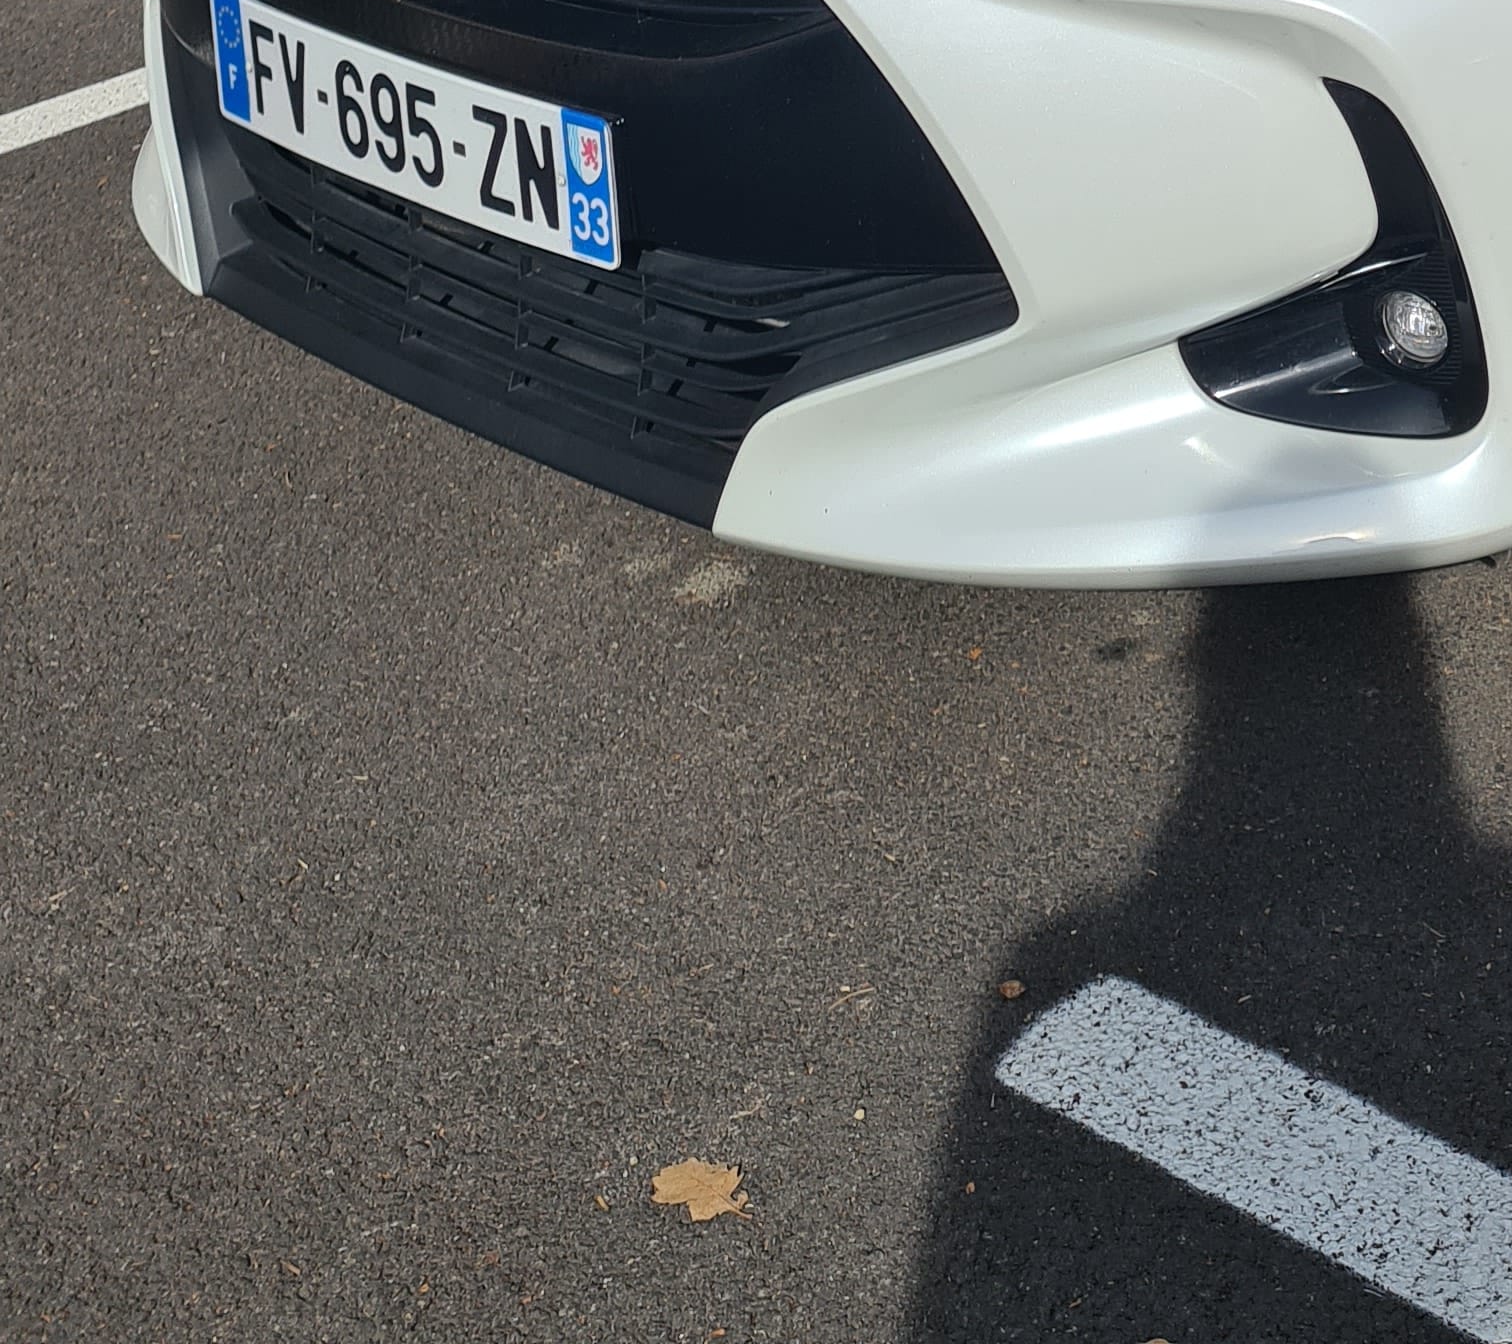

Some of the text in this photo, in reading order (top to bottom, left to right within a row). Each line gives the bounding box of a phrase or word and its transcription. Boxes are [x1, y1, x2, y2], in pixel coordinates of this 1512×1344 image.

[228, 63, 238, 90] F
[249, 18, 559, 231] FV-695-ZN
[572, 192, 609, 246] 33
